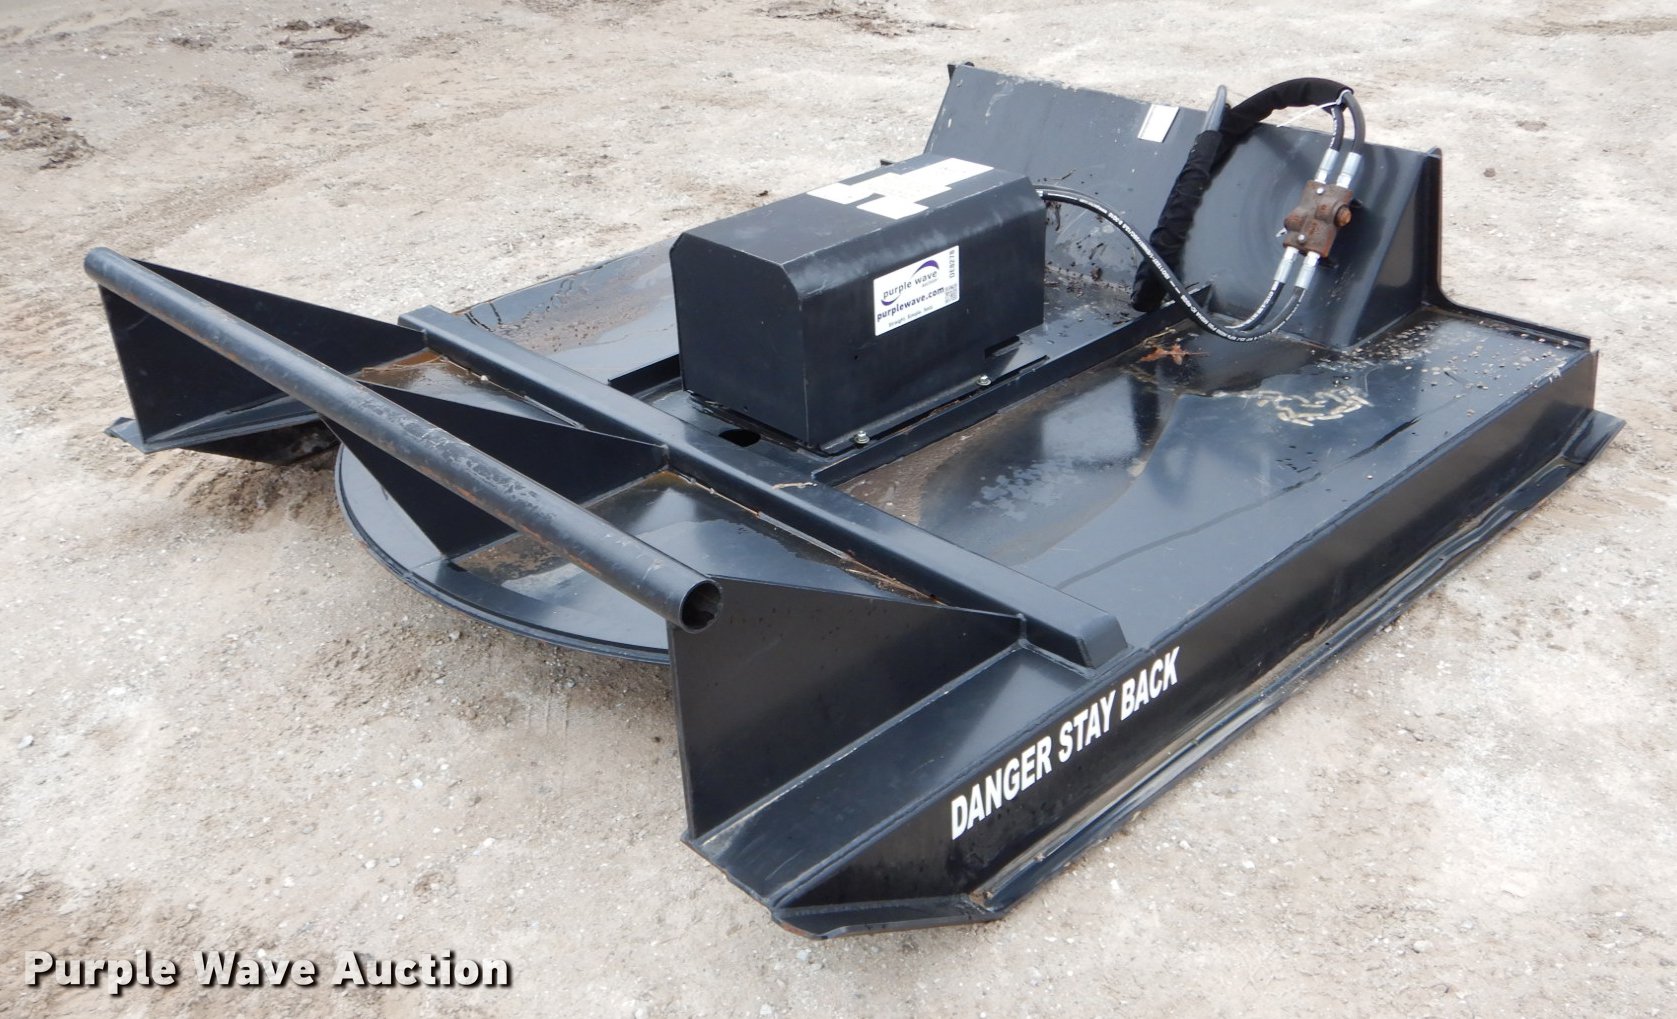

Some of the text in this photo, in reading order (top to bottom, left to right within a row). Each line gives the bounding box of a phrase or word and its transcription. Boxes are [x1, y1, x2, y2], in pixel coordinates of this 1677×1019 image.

[883, 280, 912, 300] purple
[914, 270, 938, 285] wave
[877, 286, 945, 323] purplewave.com
[951, 646, 1180, 840] DANGER STAY BACK
